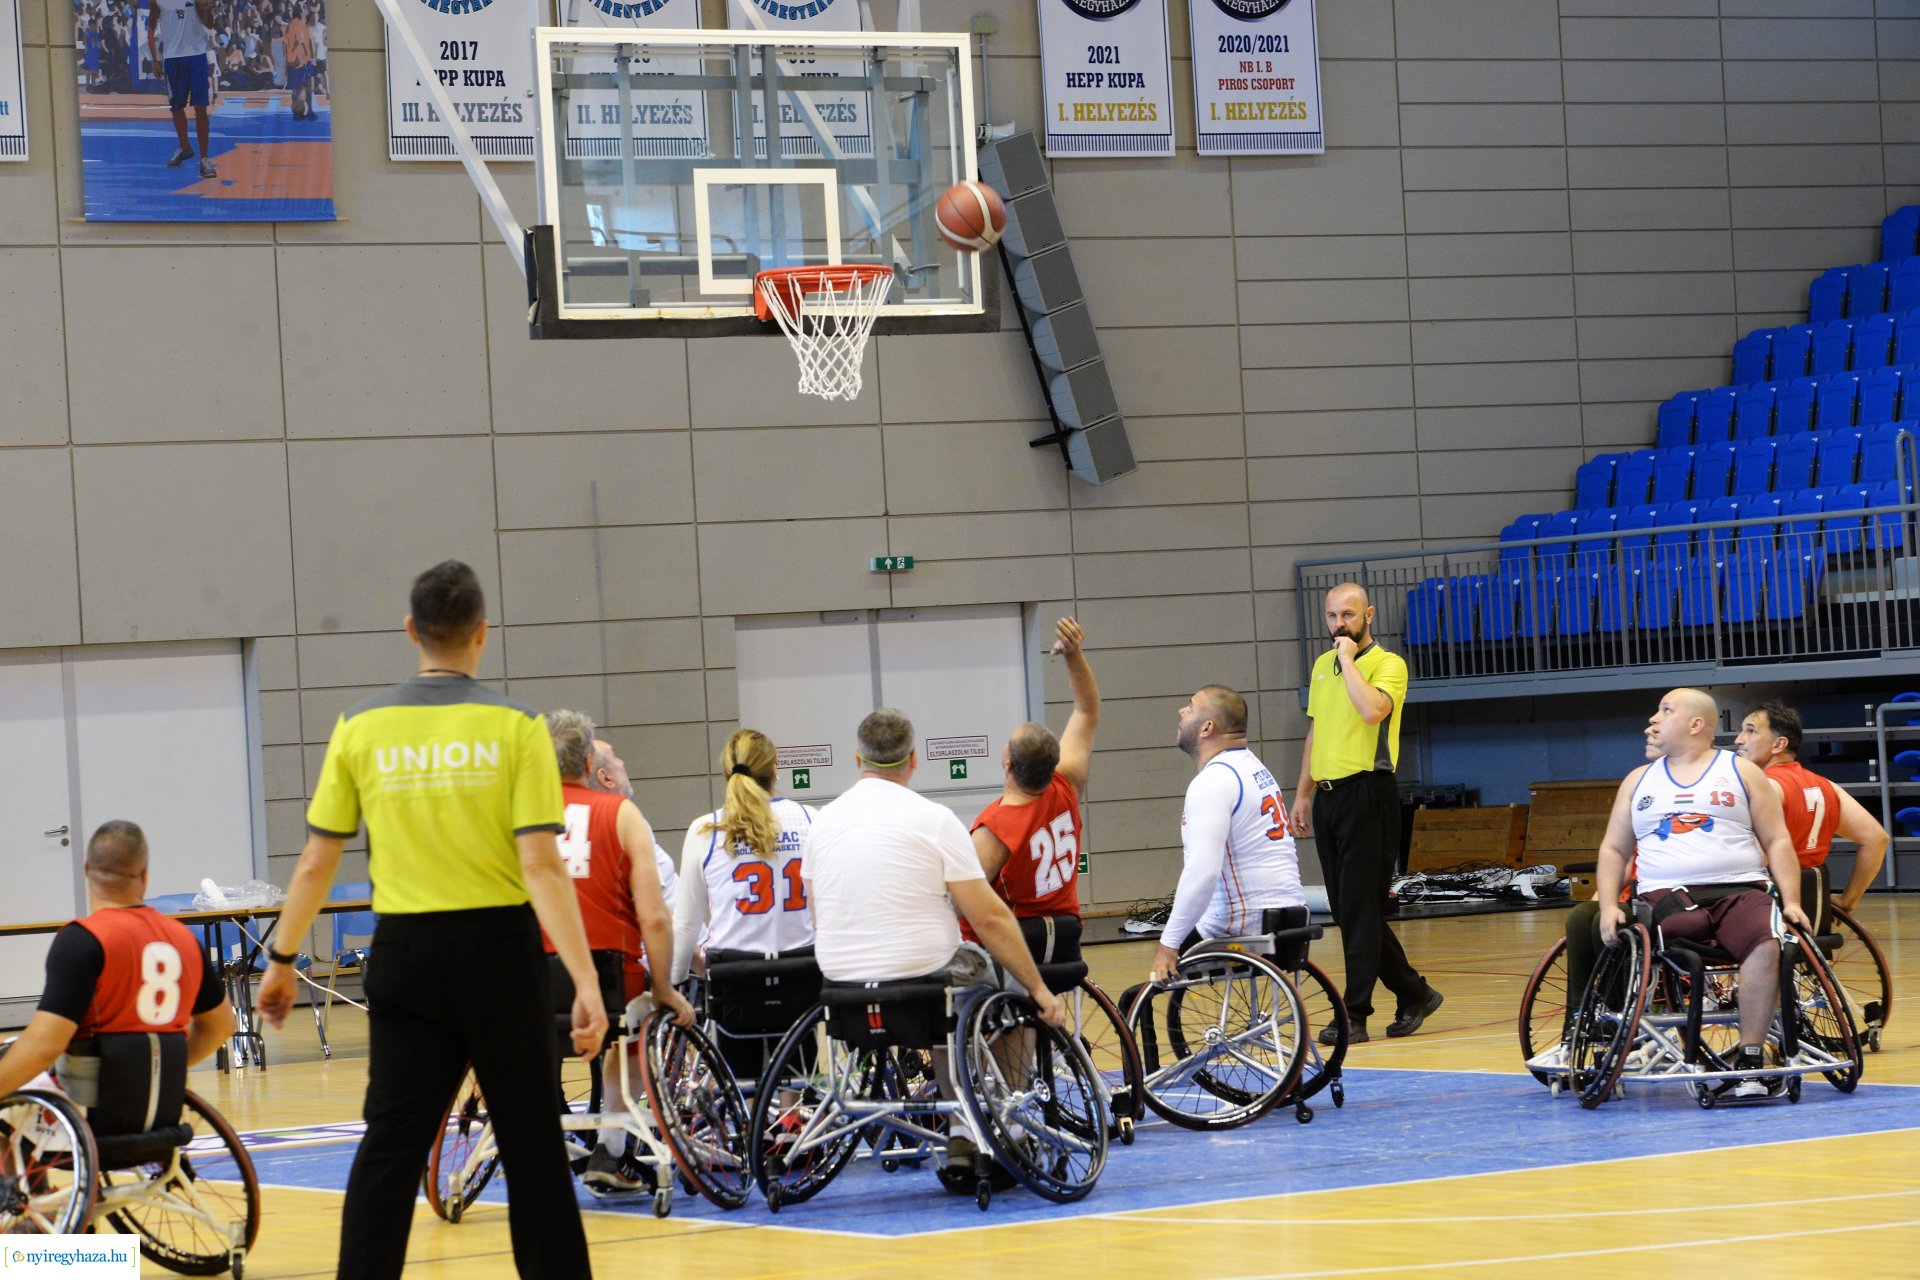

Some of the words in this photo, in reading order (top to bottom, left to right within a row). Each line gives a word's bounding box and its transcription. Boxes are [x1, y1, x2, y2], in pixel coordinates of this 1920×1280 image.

[440, 41, 478, 61] 2017
[1088, 46, 1120, 64] 2021
[1218, 34, 1290, 55] 2020/2021
[1239, 61, 1254, 73] NB
[1257, 61, 1264, 73] I.
[1266, 61, 1273, 73] B
[463, 70, 506, 87] KUPA
[1066, 73, 1104, 88] HEPP
[1108, 73, 1145, 88] KUPA
[1218, 78, 1248, 90] PIROS
[1251, 78, 1295, 90] CSOPORT
[402, 103, 424, 122] III.
[427, 97, 523, 123] HLYEZÉS
[577, 105, 596, 124] II.
[1058, 103, 1069, 121] I.
[1073, 97, 1157, 121] HELYEZÉS
[1210, 103, 1221, 120] I.
[1225, 96, 1307, 120] HELYEZÉS
[376, 741, 499, 774] UNION
[1710, 790, 1735, 807] 13
[1802, 786, 1825, 850] 7
[556, 804, 591, 878] 4
[1029, 809, 1077, 898] 25
[732, 858, 807, 916] 31
[137, 941, 182, 1025] 8
